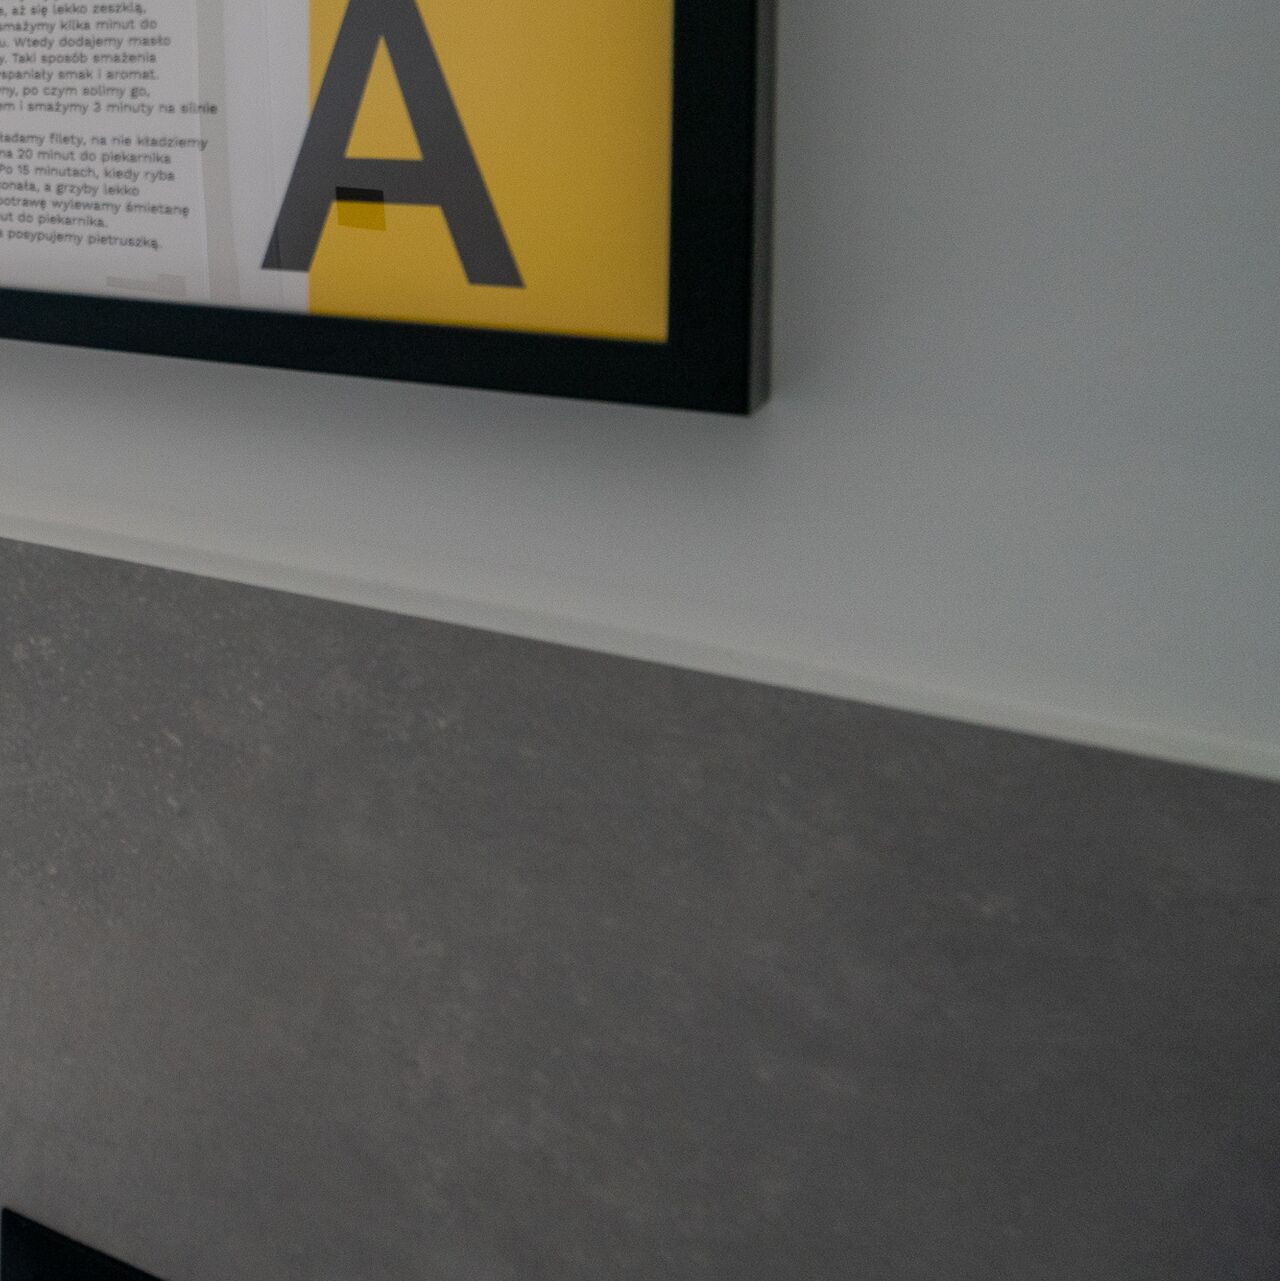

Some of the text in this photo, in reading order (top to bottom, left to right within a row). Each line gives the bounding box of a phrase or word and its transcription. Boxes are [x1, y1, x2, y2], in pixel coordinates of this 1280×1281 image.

[10, 3, 26, 15] aż
[29, 4, 48, 17] się
[51, 2, 88, 14] lekko
[58, 18, 91, 30] kilka
[94, 18, 135, 30] minut
[139, 17, 158, 29] do
[12, 35, 55, 49] Wtedy
[57, 34, 124, 49] dodajemy
[126, 33, 171, 46] masło
[17, 148, 33, 159] 20
[36, 148, 75, 160] minut
[79, 149, 96, 161] do
[99, 149, 171, 166] piekarnika
[16, 164, 30, 175] 15
[102, 166, 140, 182] kiedy
[142, 167, 175, 183] ryba
[42, 182, 52, 192] a
[54, 180, 99, 196] grzyby
[102, 182, 140, 196] lekko
[49, 196, 121, 214] wylewamy
[124, 199, 190, 218] śmietanę
[16, 210, 34, 223] do
[6, 226, 83, 244] posypujemy
